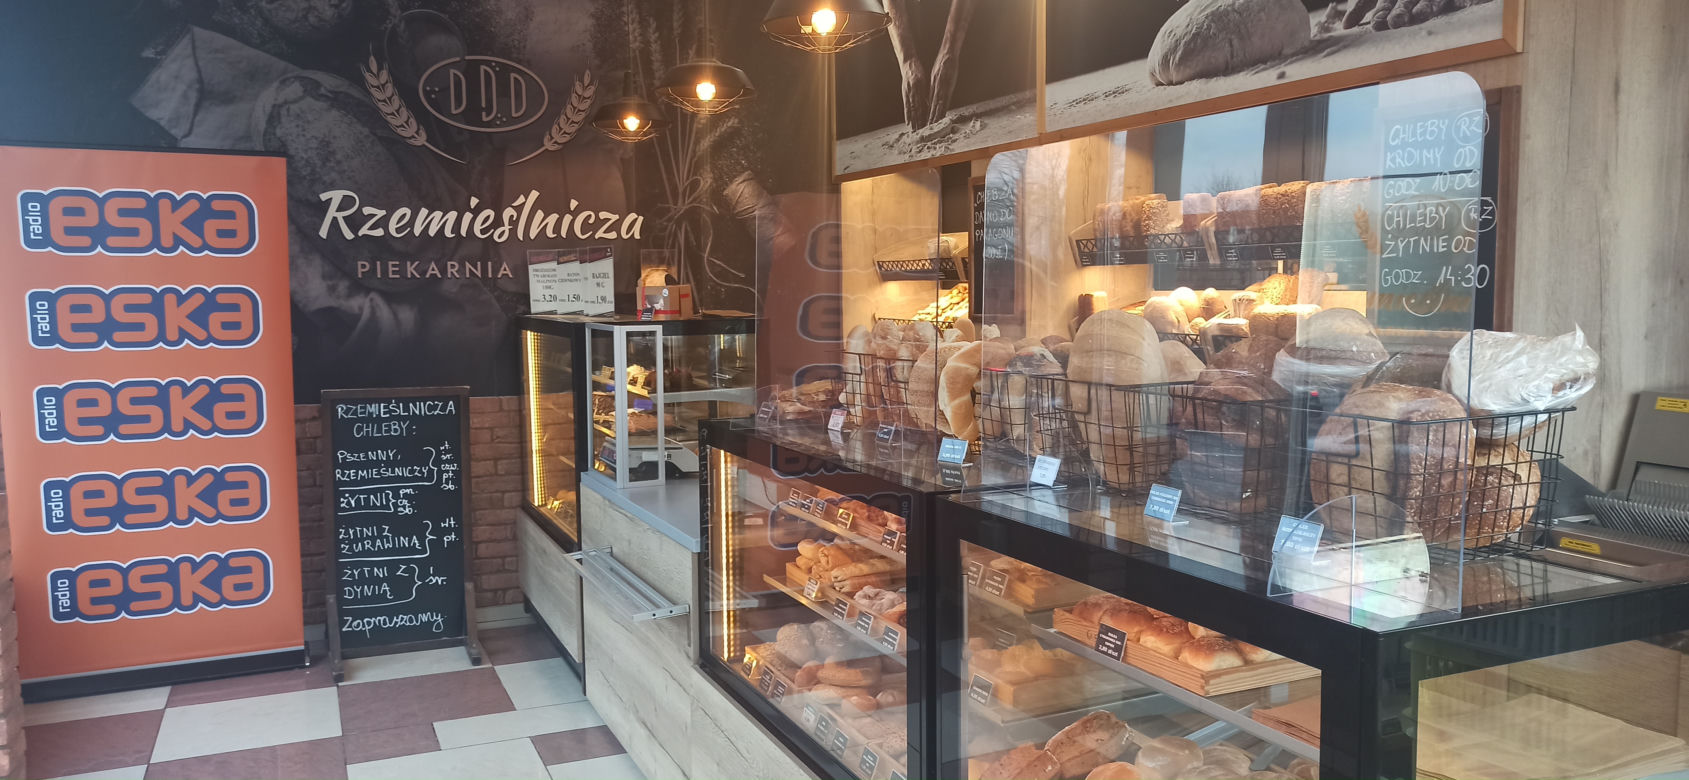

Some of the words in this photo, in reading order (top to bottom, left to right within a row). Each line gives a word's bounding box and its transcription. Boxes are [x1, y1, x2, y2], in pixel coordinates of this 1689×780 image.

[1389, 119, 1449, 146] CHLEBY
[1385, 147, 1444, 169] KROIMY
[1453, 146, 1480, 168] OD
[25, 202, 43, 239] radio
[48, 195, 250, 249] eska
[318, 189, 645, 242] Rzemieślnicza
[1384, 206, 1450, 231] CHLEBY
[1382, 234, 1448, 258] ŻYTNIE
[357, 260, 514, 279] PIEKARNIA
[1382, 268, 1427, 288] GODZ.
[1436, 264, 1490, 288] 14:30
[33, 300, 50, 337] radio
[56, 292, 254, 344] eska
[40, 396, 58, 431] radio
[63, 383, 258, 437] eska
[336, 400, 456, 419] RZEMIEŚLNICZA
[336, 464, 429, 481] RZEMIEŚLNICZY
[48, 489, 64, 523] radio
[69, 470, 262, 528] eska
[340, 493, 386, 508] ŻYTNI
[339, 525, 377, 539] ŻYTNI
[340, 535, 422, 554] ŻURAWINĄ
[342, 566, 388, 580] ŻYTNI
[396, 564, 409, 576] Z
[54, 578, 71, 612] radio
[75, 555, 265, 616] eska
[343, 582, 394, 599] DYNIĄ
